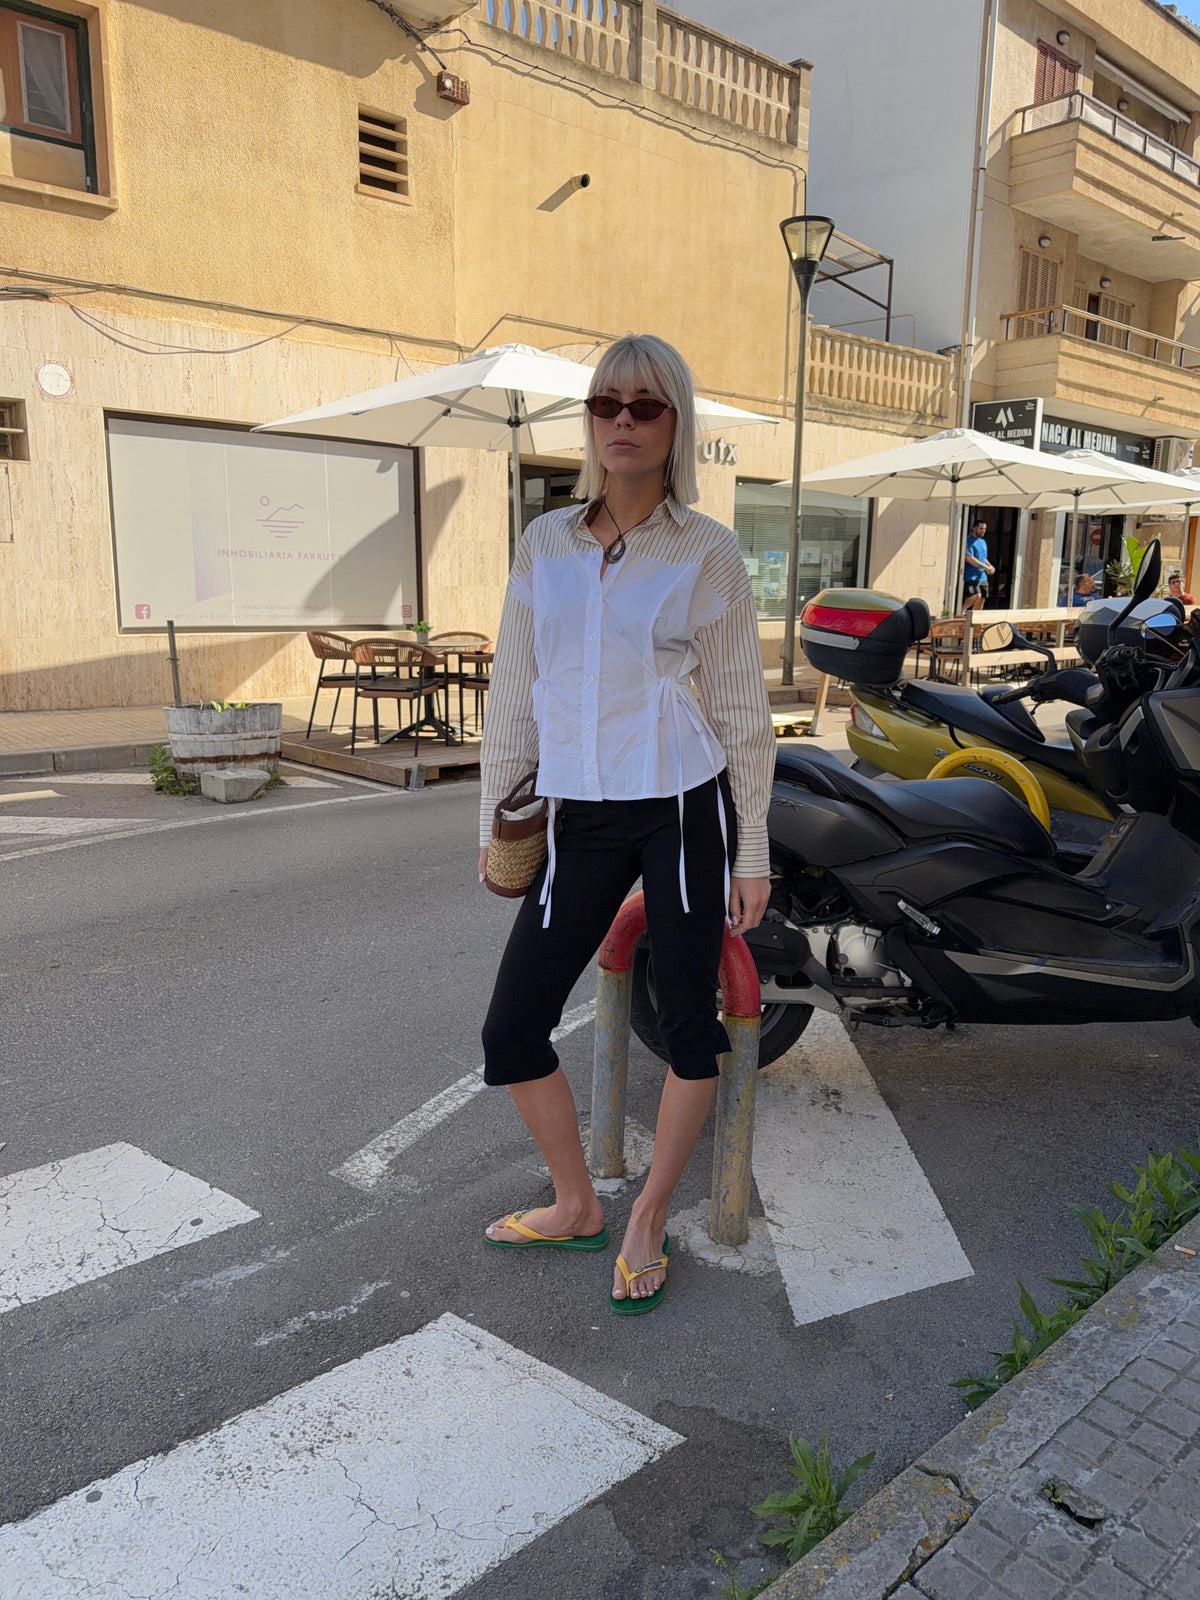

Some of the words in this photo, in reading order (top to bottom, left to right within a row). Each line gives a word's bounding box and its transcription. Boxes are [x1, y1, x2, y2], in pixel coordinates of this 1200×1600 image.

[997, 429, 1006, 439] AL
[1007, 428, 1032, 438] MEDINA
[1069, 428, 1081, 448] AL
[1083, 430, 1117, 454] MEDINA
